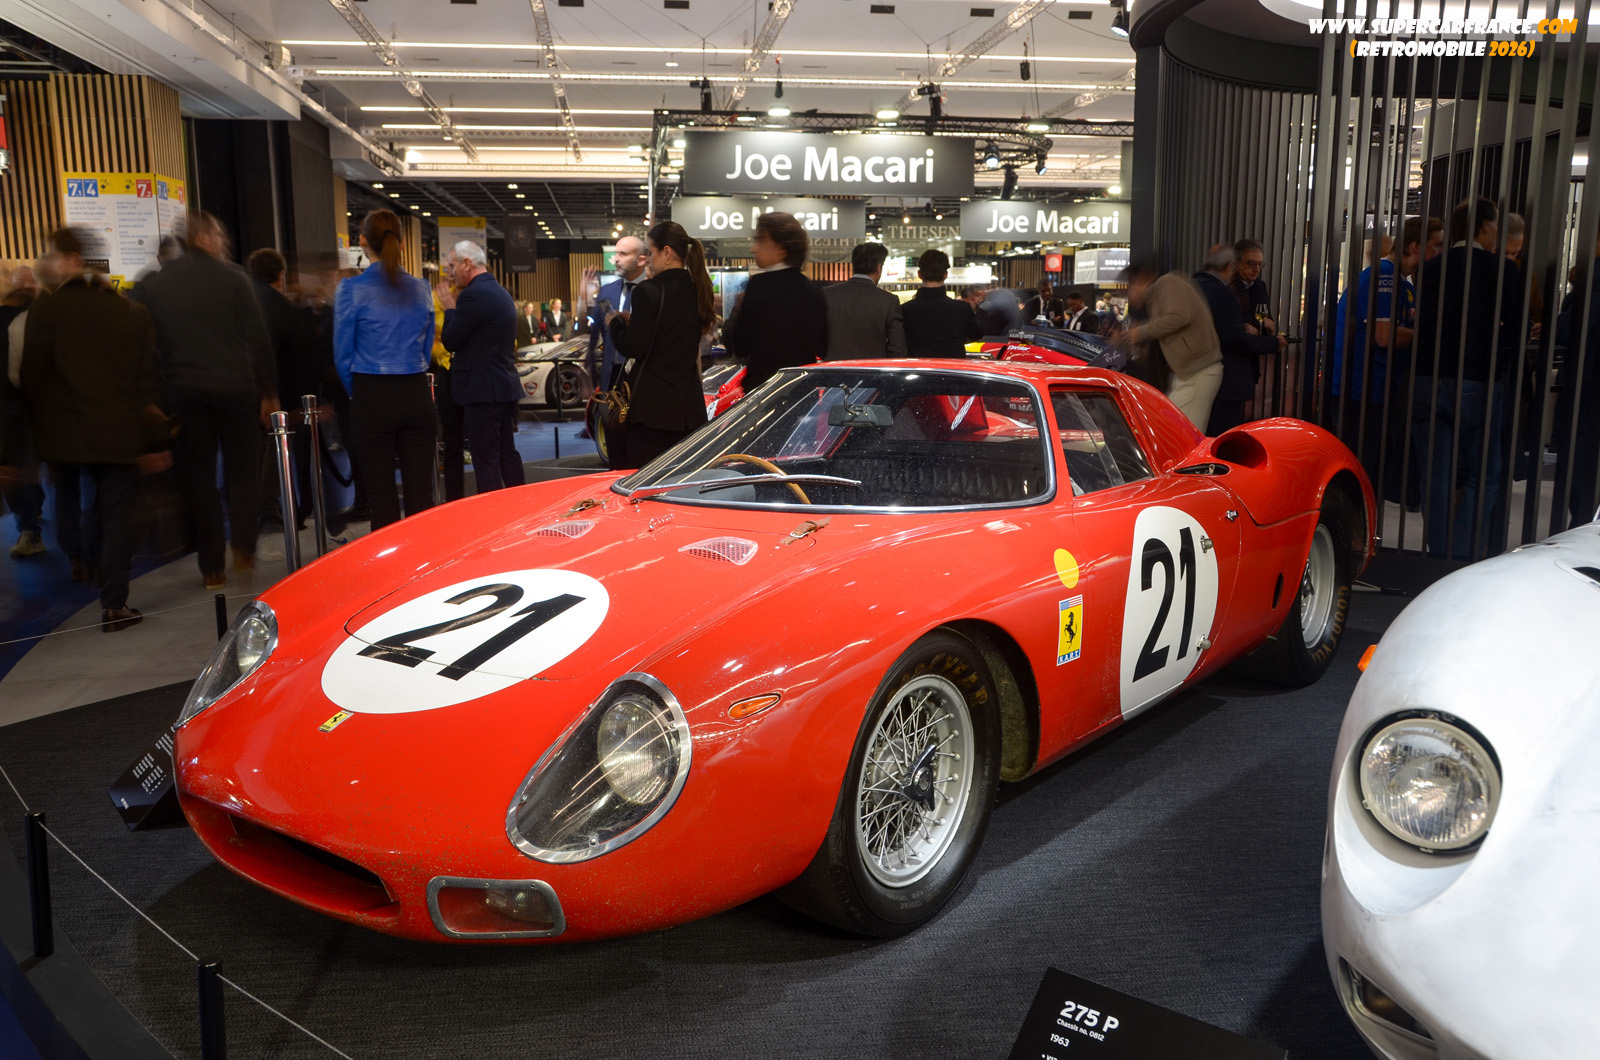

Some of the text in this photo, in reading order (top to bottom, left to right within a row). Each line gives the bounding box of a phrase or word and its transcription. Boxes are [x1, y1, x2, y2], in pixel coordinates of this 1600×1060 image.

[725, 144, 935, 184] Joe Macari
[86, 184, 96, 196] 4
[699, 206, 838, 231] Joe Mcari
[986, 209, 1120, 235] Joe Macari
[888, 225, 960, 240] THIESEN
[1132, 526, 1197, 684] 21
[356, 582, 588, 682] 21
[1060, 1000, 1119, 1033] 275 P
[1050, 1033, 1070, 1047] 1963
[1056, 1018, 1079, 1032] Chassis
[1089, 1030, 1105, 1042] 0812
